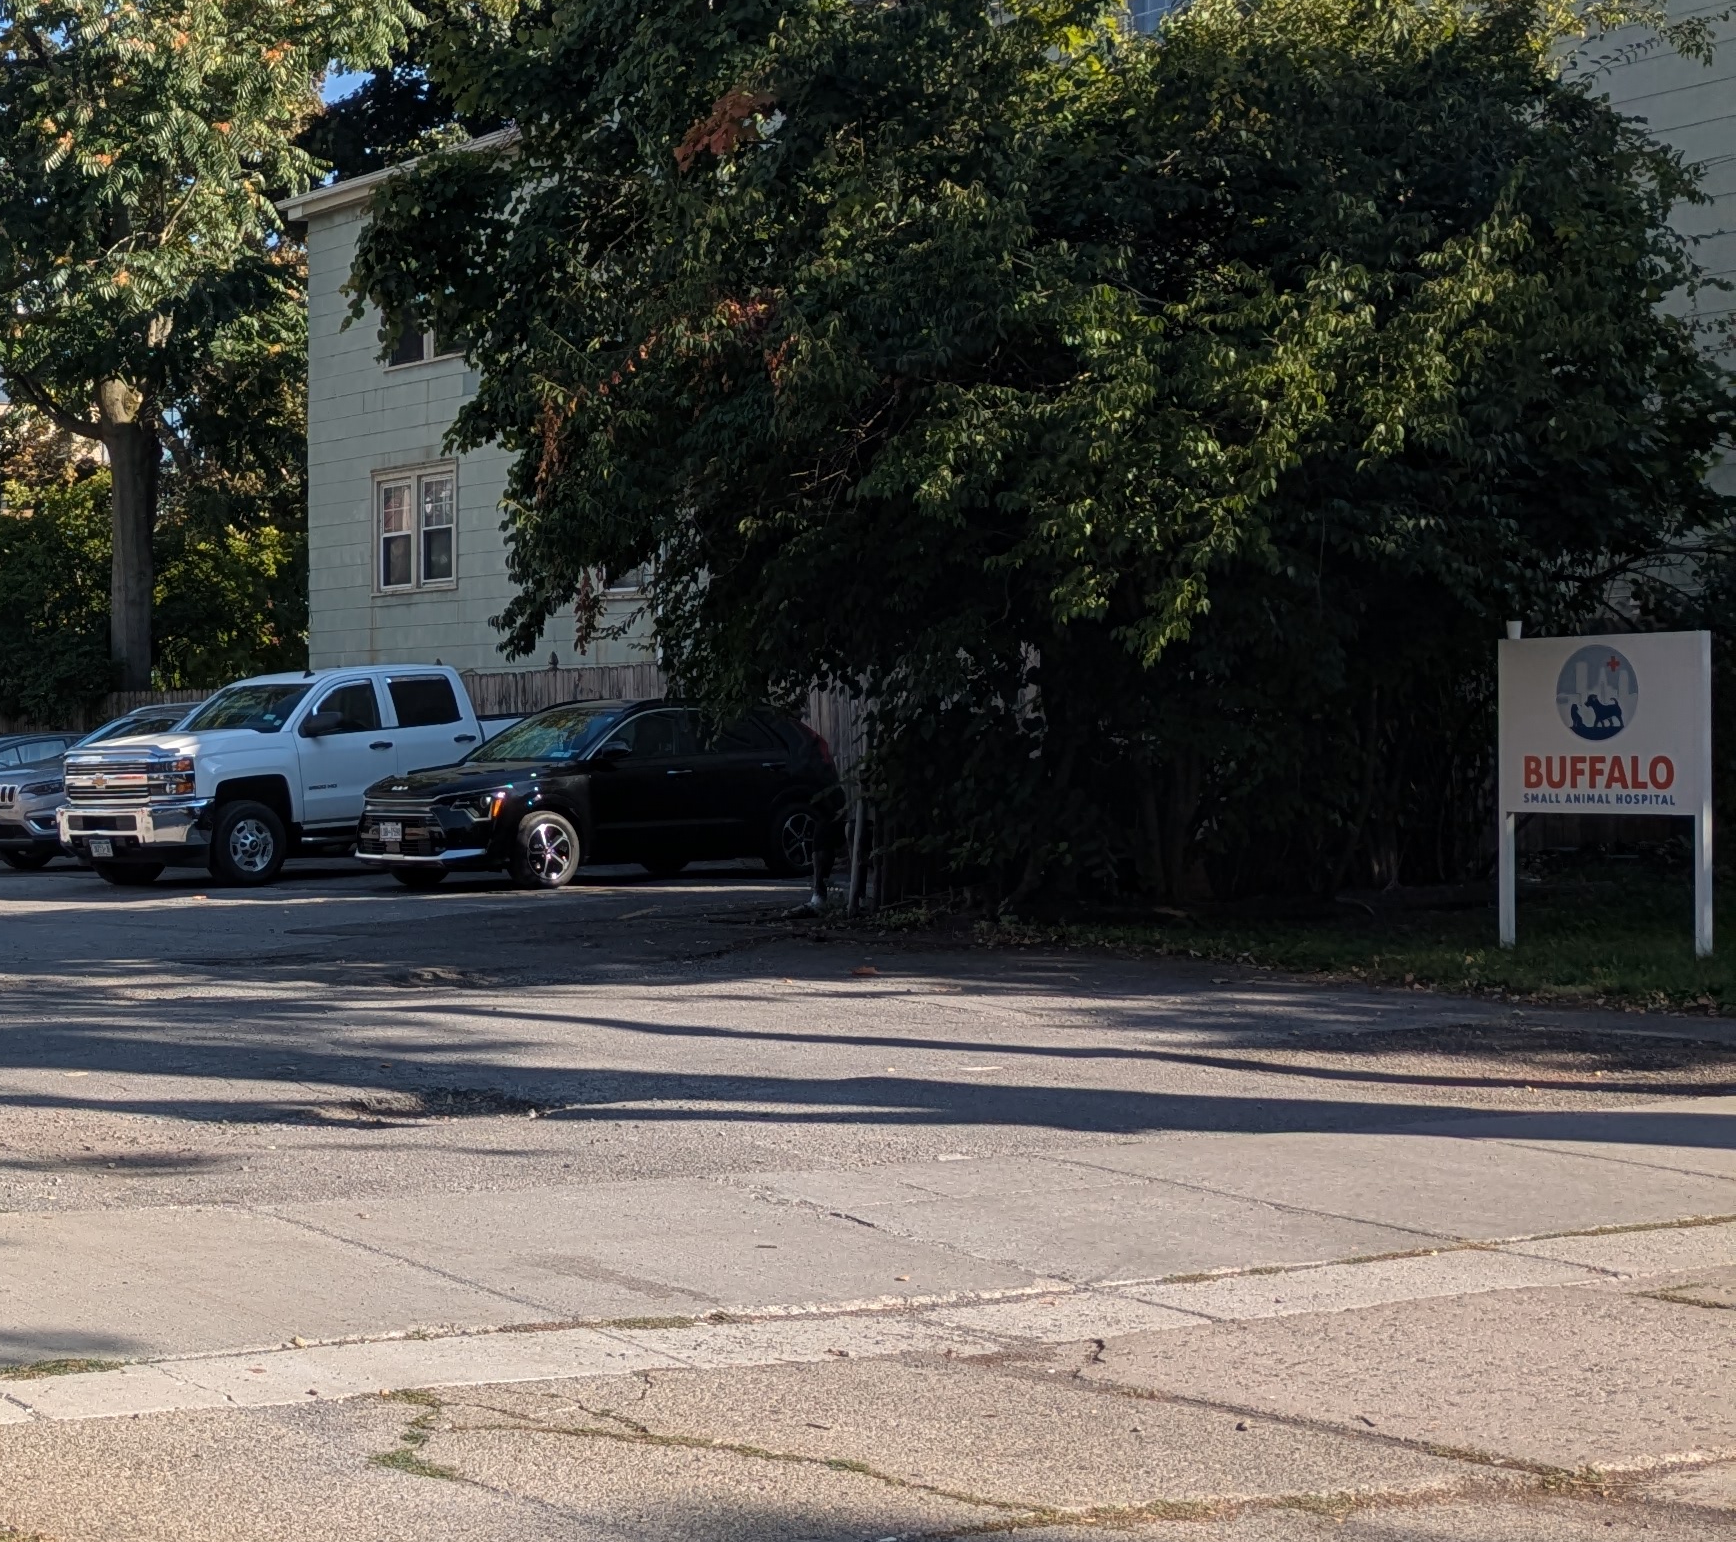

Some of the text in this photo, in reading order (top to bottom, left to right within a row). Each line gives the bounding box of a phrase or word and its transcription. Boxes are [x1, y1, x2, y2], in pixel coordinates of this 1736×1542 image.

[1524, 755, 1675, 790] BUFFALO
[1523, 792, 1676, 806] SMALL ANIMAL HOSPITAL
